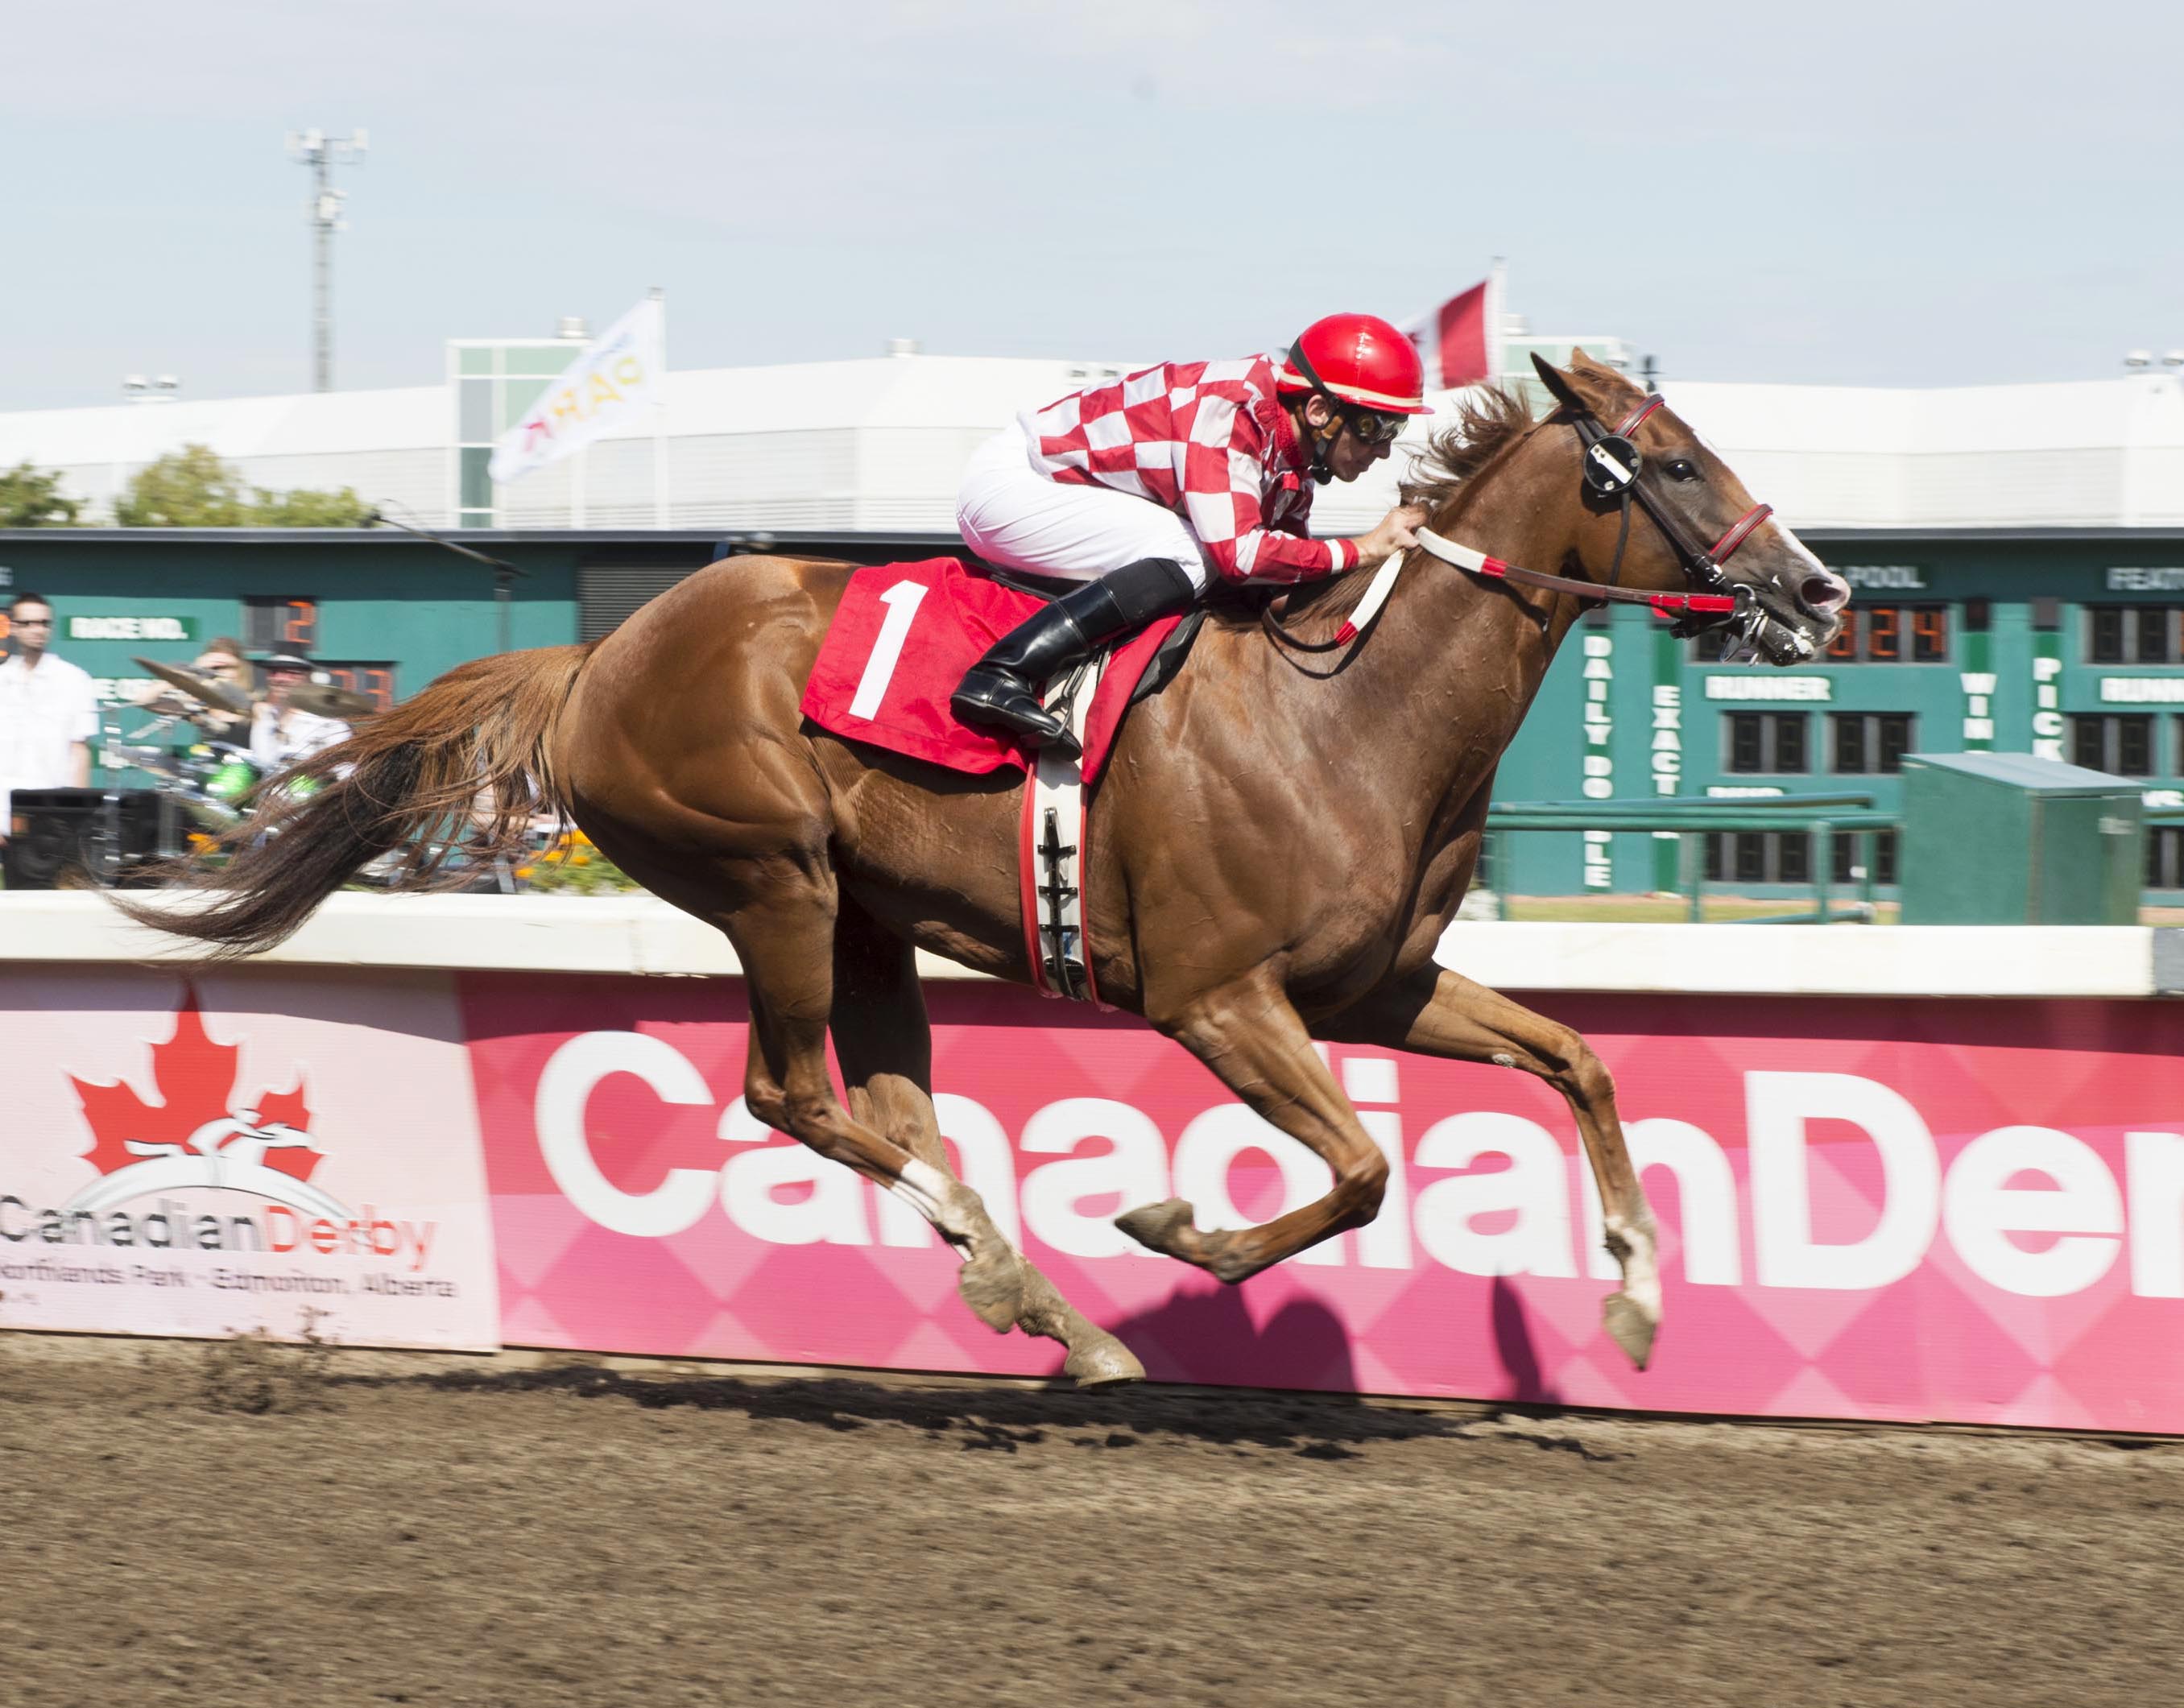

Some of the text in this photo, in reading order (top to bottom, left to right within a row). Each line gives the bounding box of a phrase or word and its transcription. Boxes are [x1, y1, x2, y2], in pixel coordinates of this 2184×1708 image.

[1590, 444, 1633, 484] 1
[284, 601, 316, 643] 2
[849, 579, 929, 721] 1
[1582, 635, 1613, 887] DAILY DOLE
[2033, 658, 2064, 762] PICK
